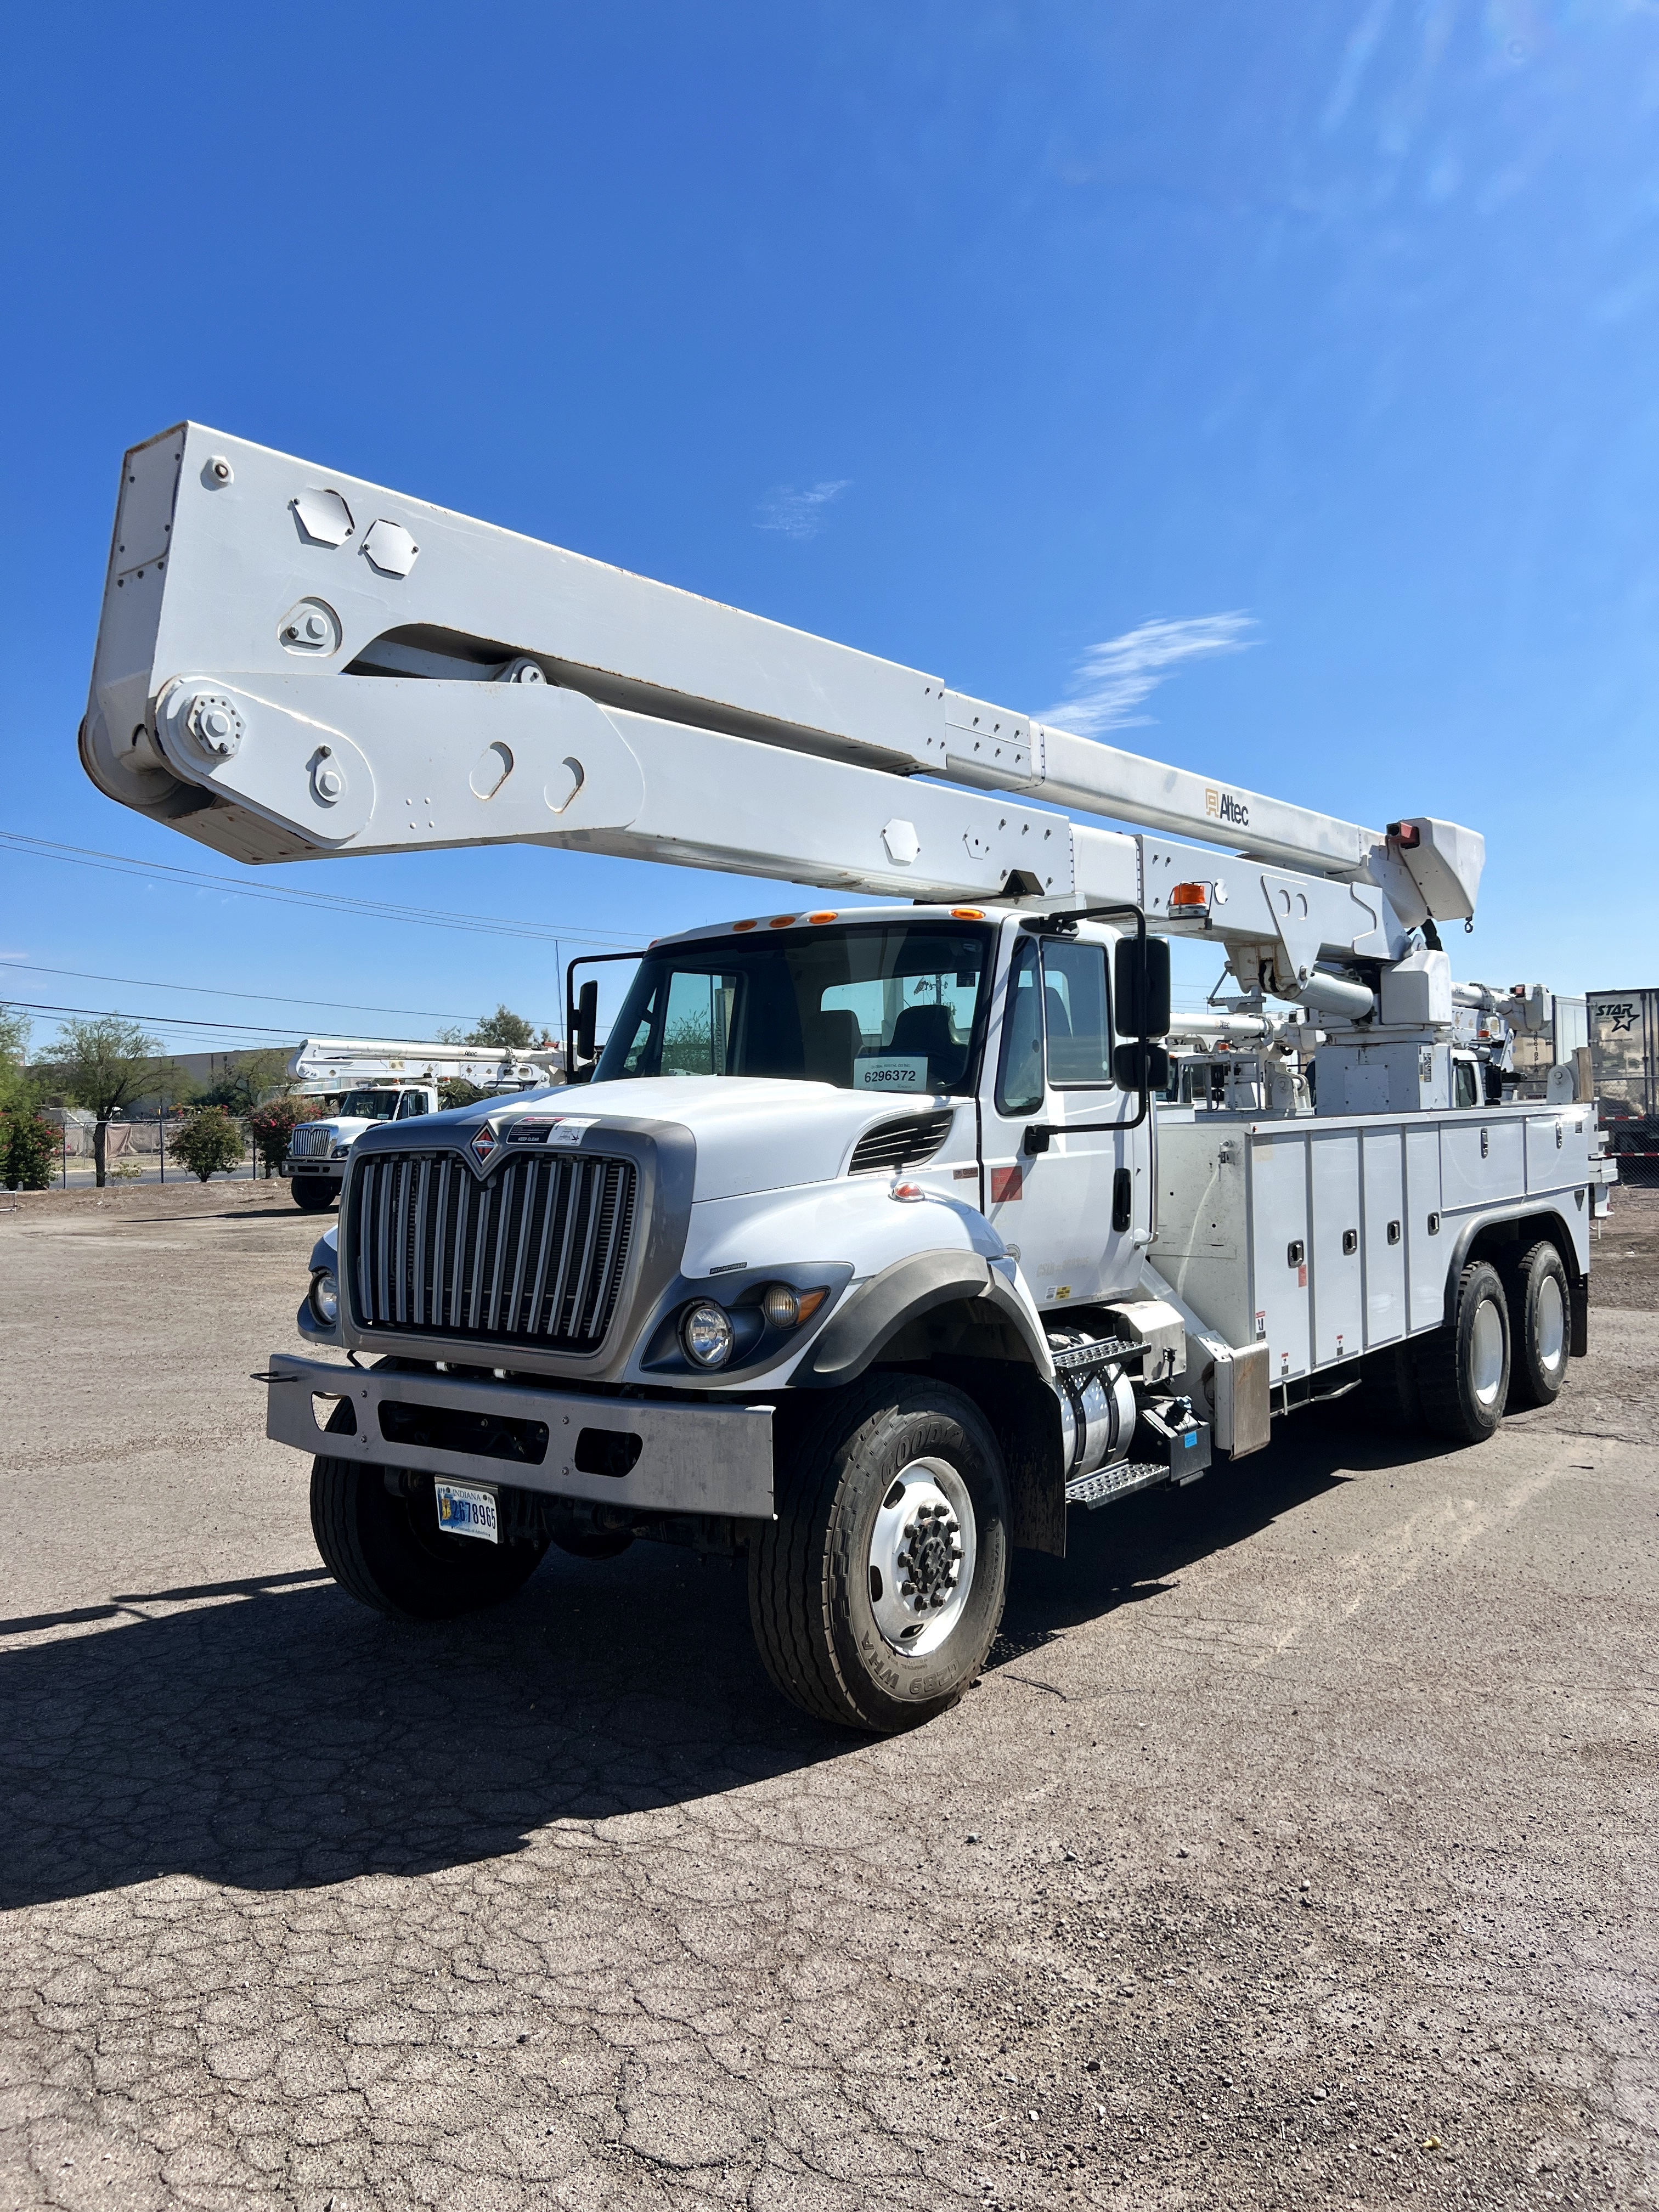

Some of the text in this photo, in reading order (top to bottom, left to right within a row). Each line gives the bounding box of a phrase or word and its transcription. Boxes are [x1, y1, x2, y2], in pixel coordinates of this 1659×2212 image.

[1220, 793, 1249, 826] Altec
[1595, 1003, 1633, 1016] STAR
[864, 1070, 916, 1083] 6296372
[453, 1489, 481, 1501] INDIANA
[452, 1500, 496, 1530] 2678965
[909, 1658, 960, 1694] G289
